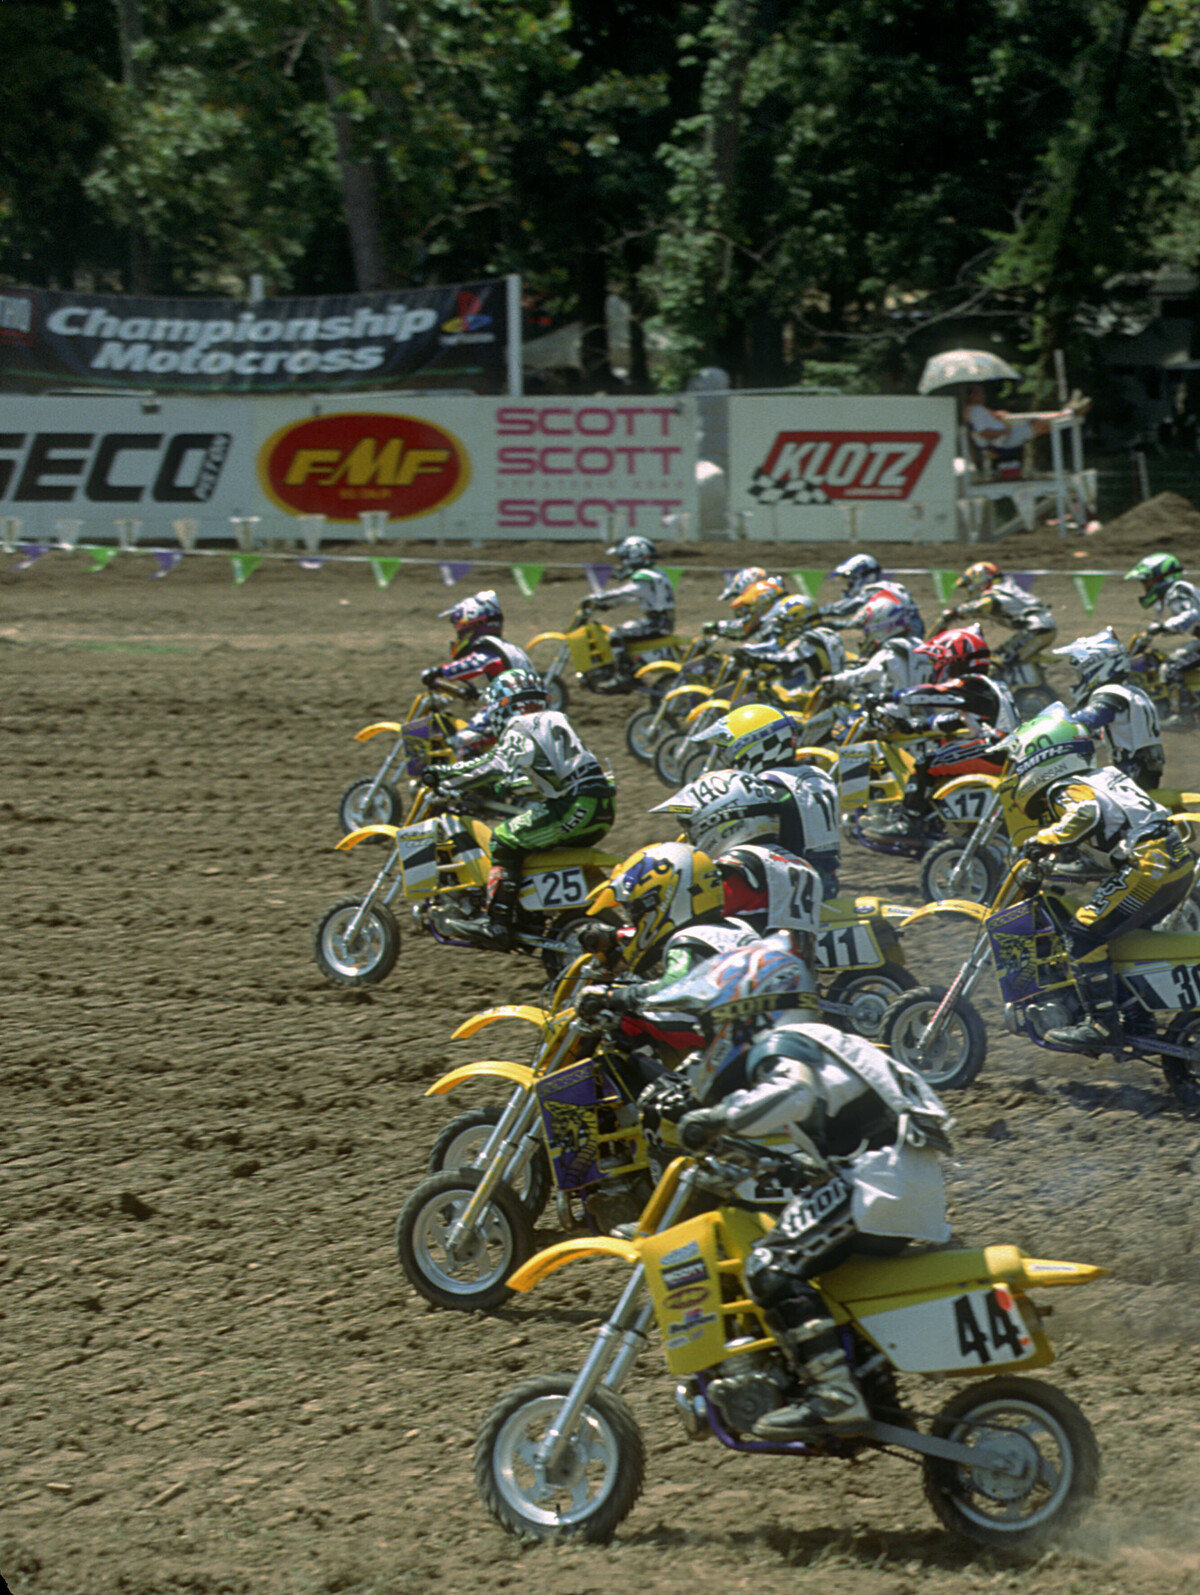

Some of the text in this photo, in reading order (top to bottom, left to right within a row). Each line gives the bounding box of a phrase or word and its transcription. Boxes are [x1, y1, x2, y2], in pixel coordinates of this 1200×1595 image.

[46, 304, 439, 351] Championship
[91, 341, 387, 375] Motocross
[496, 407, 682, 437] SCOTT
[284, 436, 449, 486] FMF
[496, 447, 682, 475] SCOTT
[770, 441, 926, 487] KLOTZ
[496, 498, 682, 528] SCOTT
[1016, 745, 1066, 775] SMITH
[954, 791, 987, 818] 17
[541, 869, 582, 906] 25
[818, 926, 860, 968] 11
[954, 1289, 1026, 1365] 44
